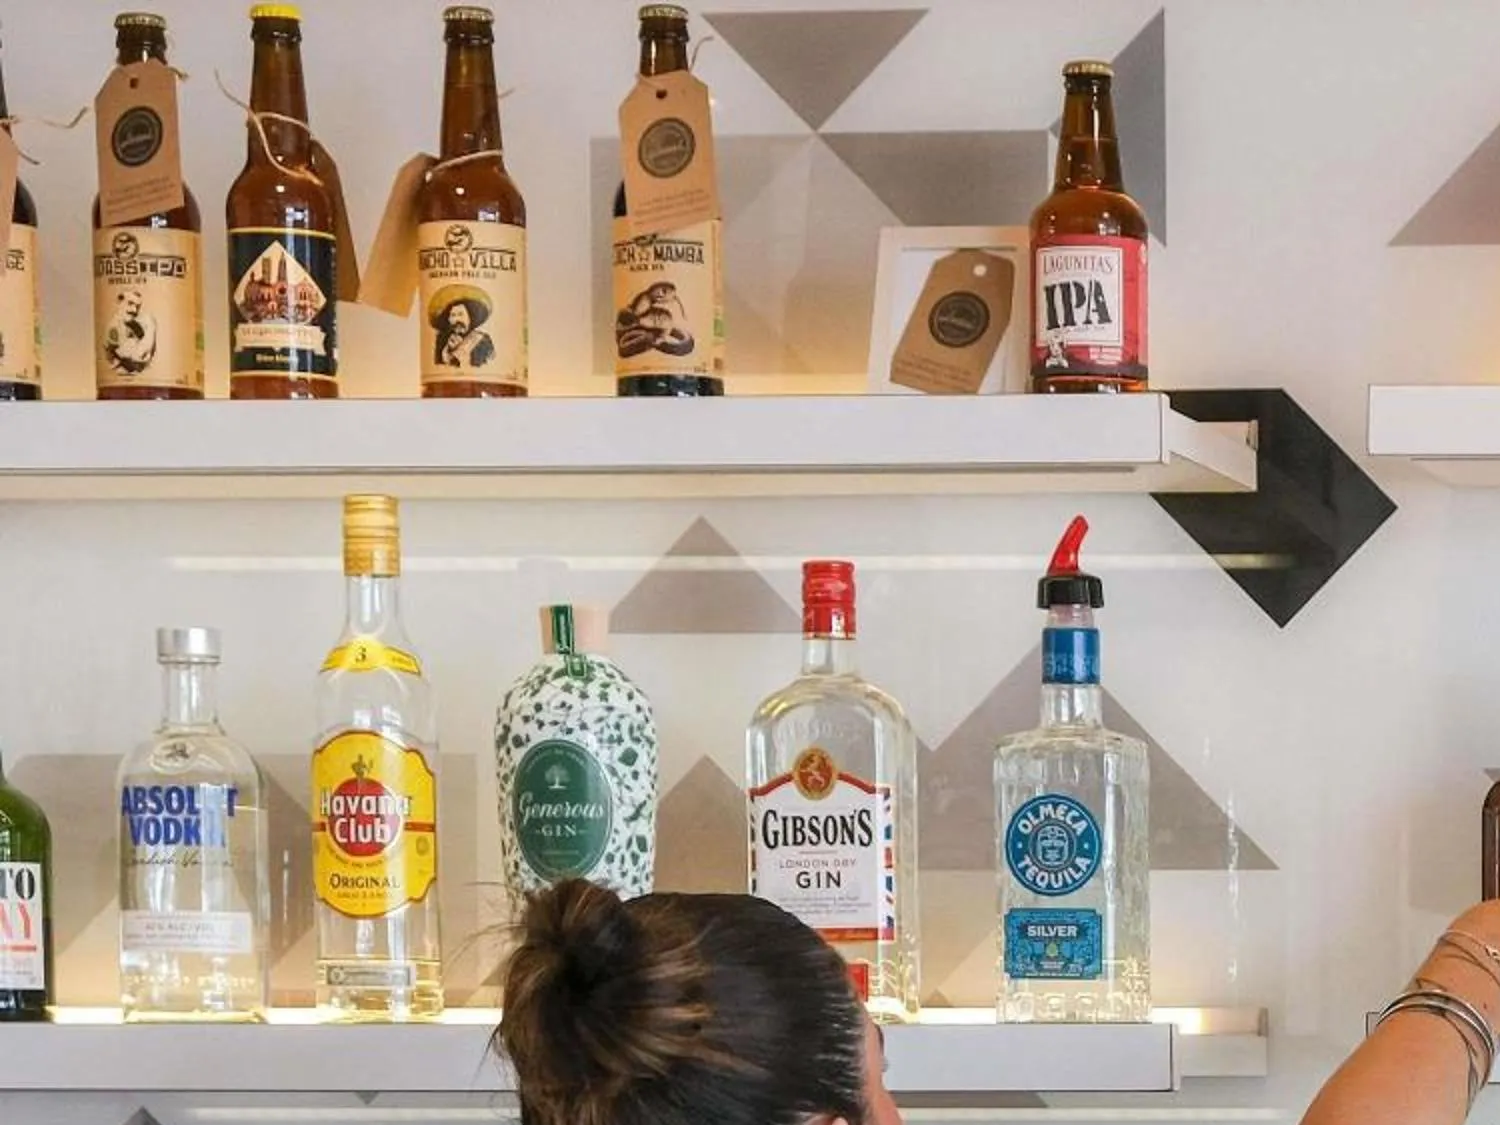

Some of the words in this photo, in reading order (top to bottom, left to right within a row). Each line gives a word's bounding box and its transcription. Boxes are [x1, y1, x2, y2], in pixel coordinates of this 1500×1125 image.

[469, 252, 517, 272] VILLA
[1043, 254, 1113, 275] LAGUNITAS
[1043, 279, 1113, 330] IPA
[122, 784, 239, 817] ABSOLT
[319, 787, 412, 817] Havana
[519, 791, 605, 825] Generous
[334, 818, 393, 844] Club
[541, 824, 577, 837] GIN
[761, 809, 874, 850] GIBSON'S
[1017, 803, 1089, 837] OLMECA
[329, 873, 401, 890] ORIGINAL
[795, 869, 843, 890] GIN
[1017, 855, 1092, 889] TEQUILA
[1027, 924, 1079, 937] SILVER
